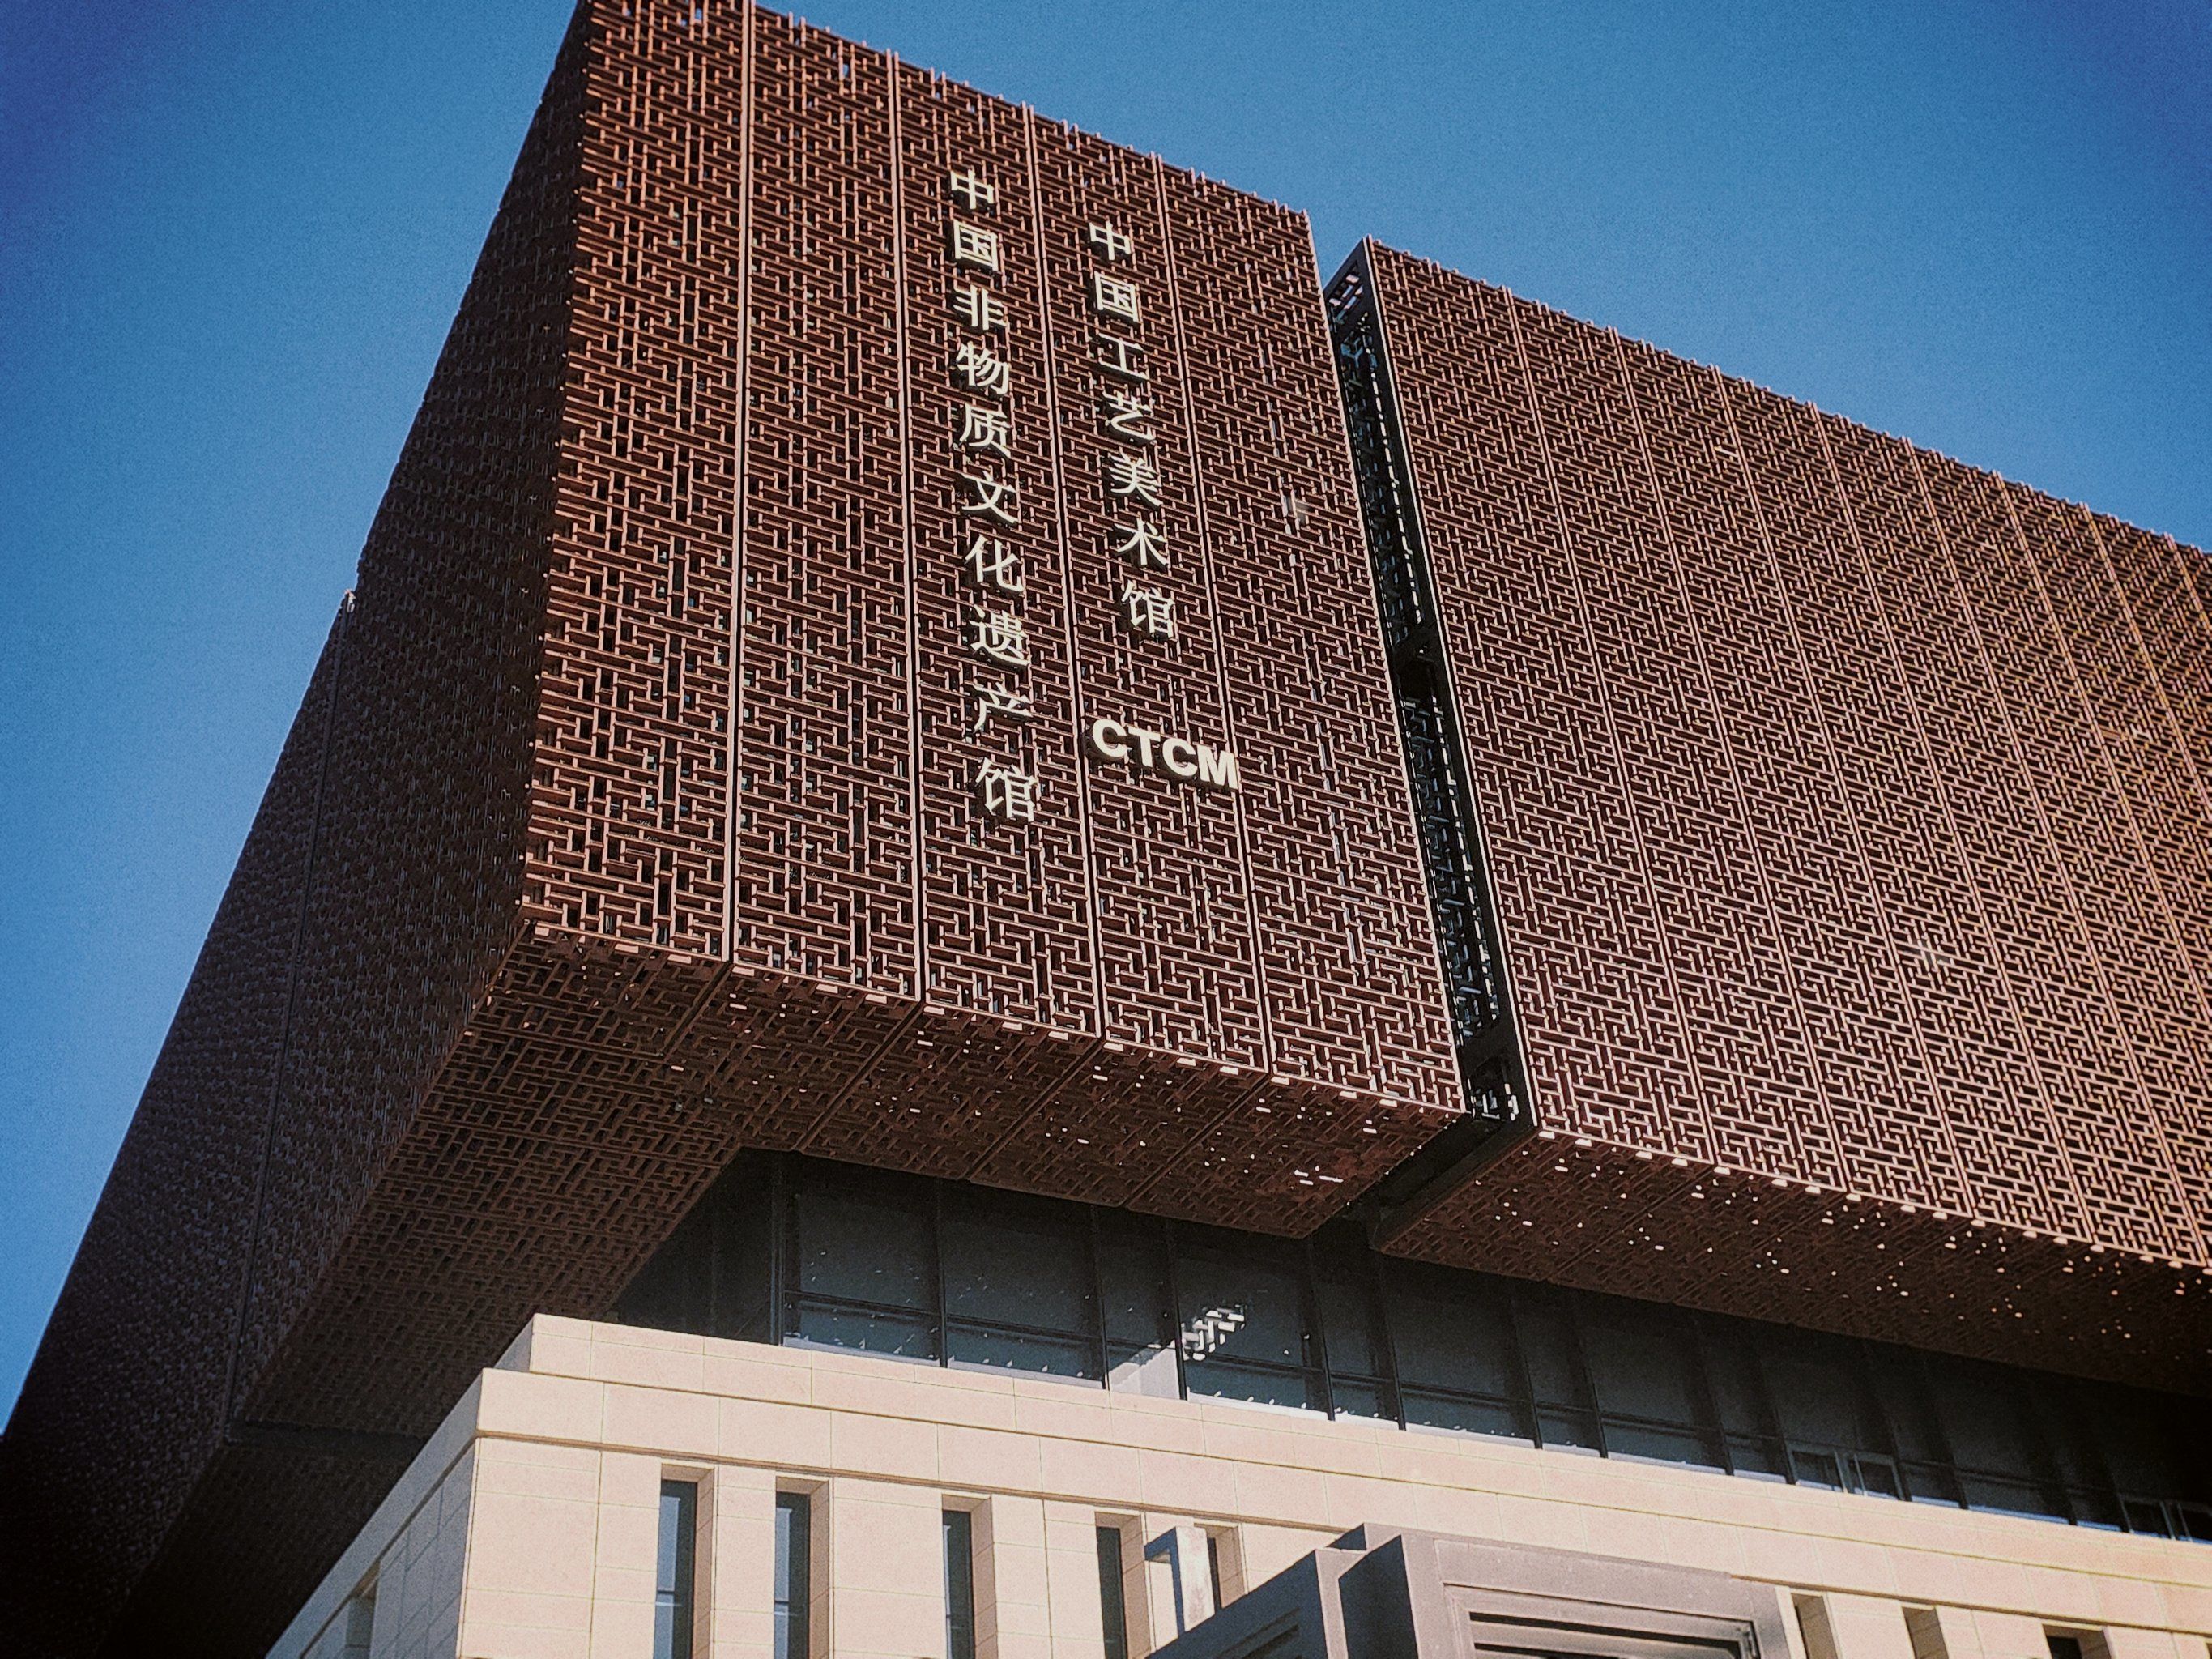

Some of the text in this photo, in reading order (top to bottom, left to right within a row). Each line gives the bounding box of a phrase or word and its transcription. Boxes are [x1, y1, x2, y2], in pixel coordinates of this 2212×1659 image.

[950, 169, 1035, 822] 中国非物质文化遗产馆
[1089, 221, 1174, 638] 中国工艺美术馆
[1092, 719, 1238, 789] CTCM
